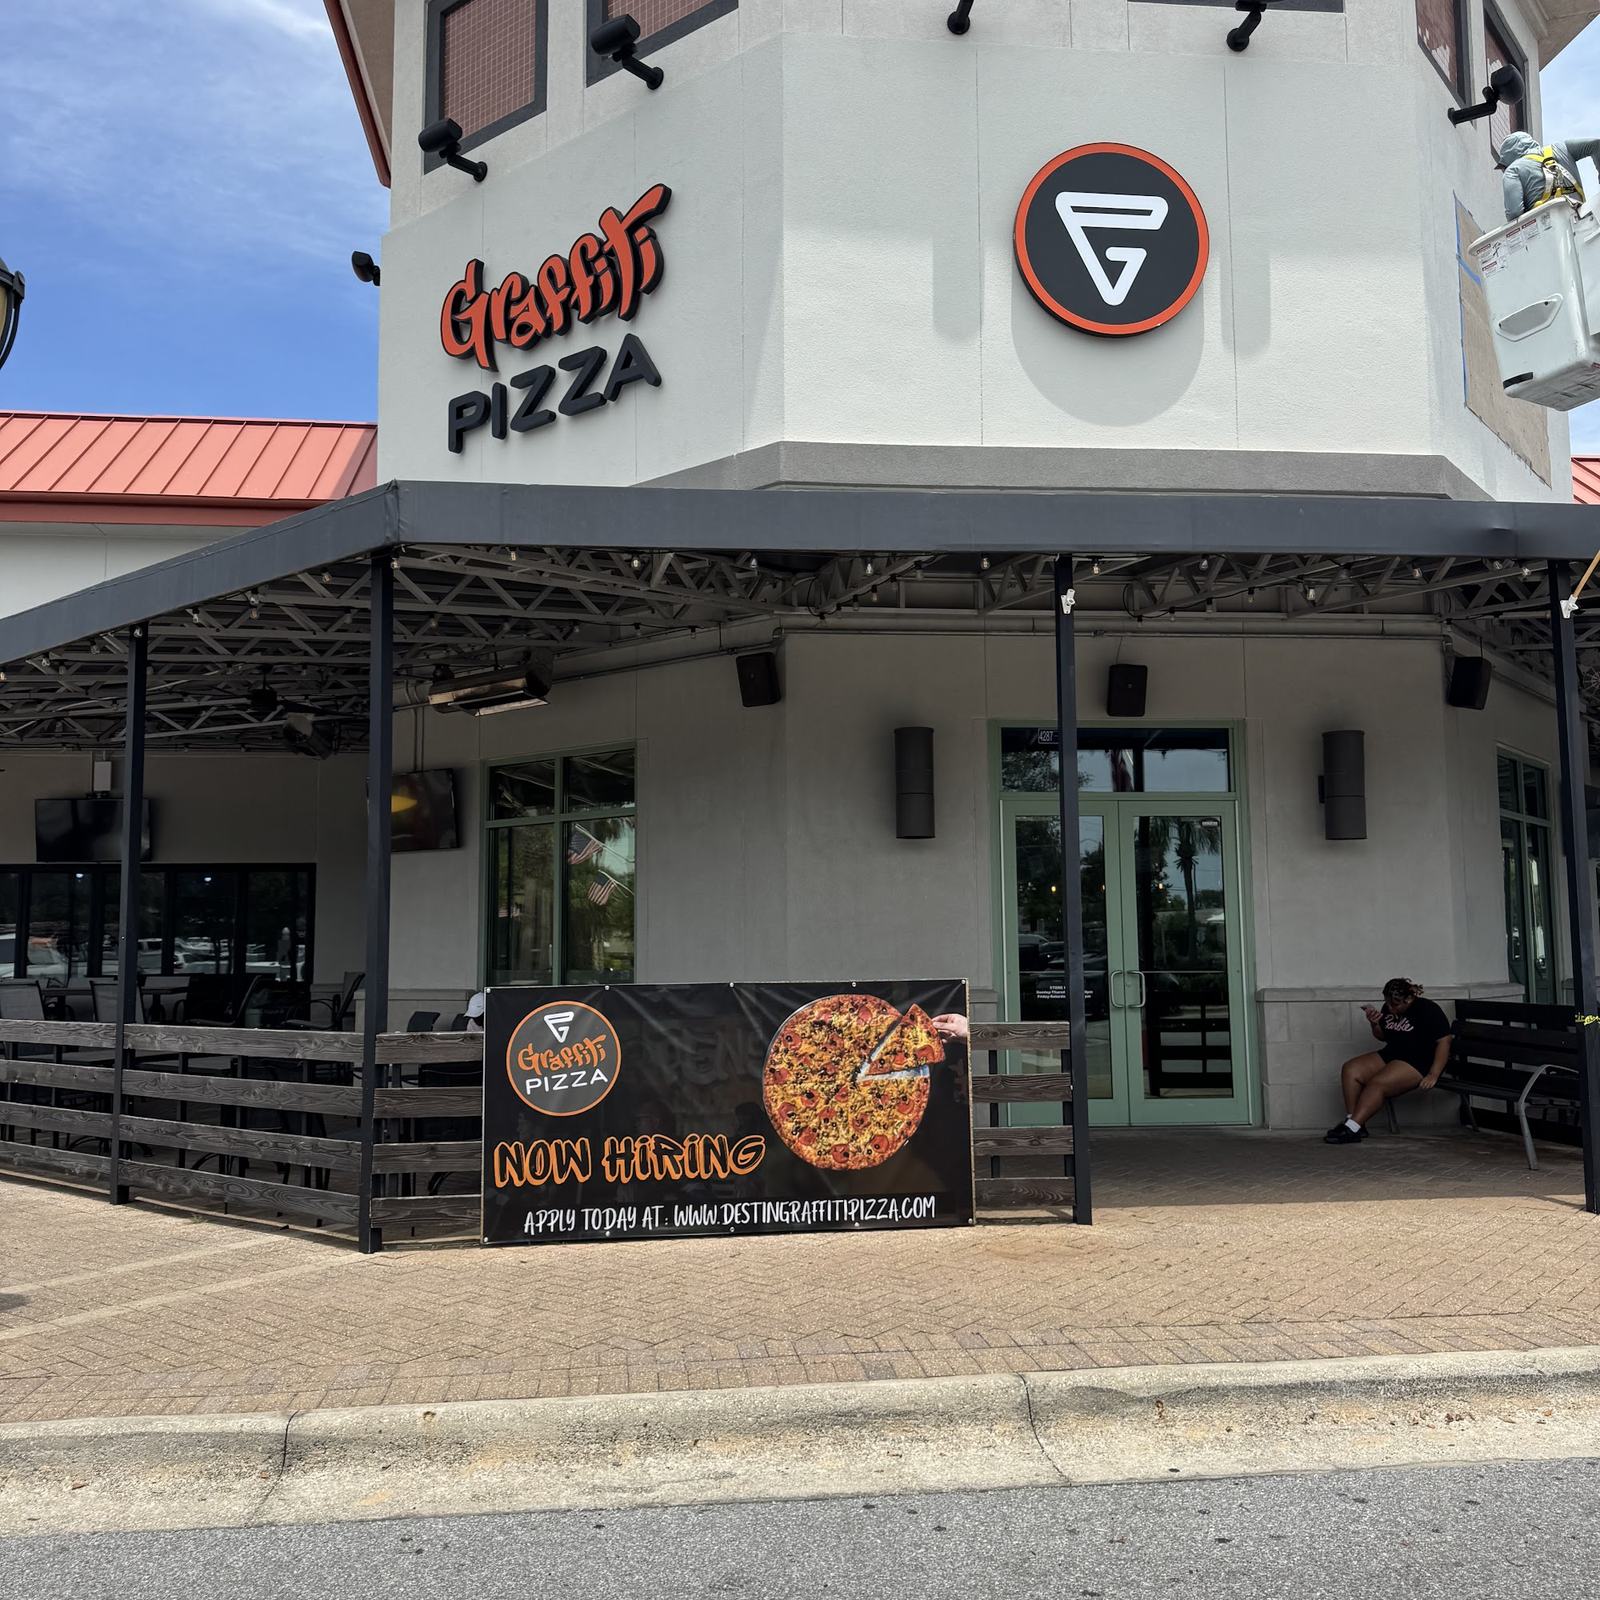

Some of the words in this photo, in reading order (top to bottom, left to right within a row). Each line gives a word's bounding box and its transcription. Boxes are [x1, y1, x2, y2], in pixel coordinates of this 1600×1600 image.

[440, 183, 672, 372] Graffiti
[448, 333, 662, 453] PIZZA
[1039, 731, 1053, 741] 4287
[518, 1034, 606, 1075] Graffiti
[525, 1068, 609, 1095] PIZZA
[494, 1137, 591, 1188] NOW
[524, 1208, 576, 1236] APPLY
[581, 1206, 637, 1230] TODAY
[674, 1195, 936, 1227] WWW.DESTINGRAFFITIPIZZA.COM
